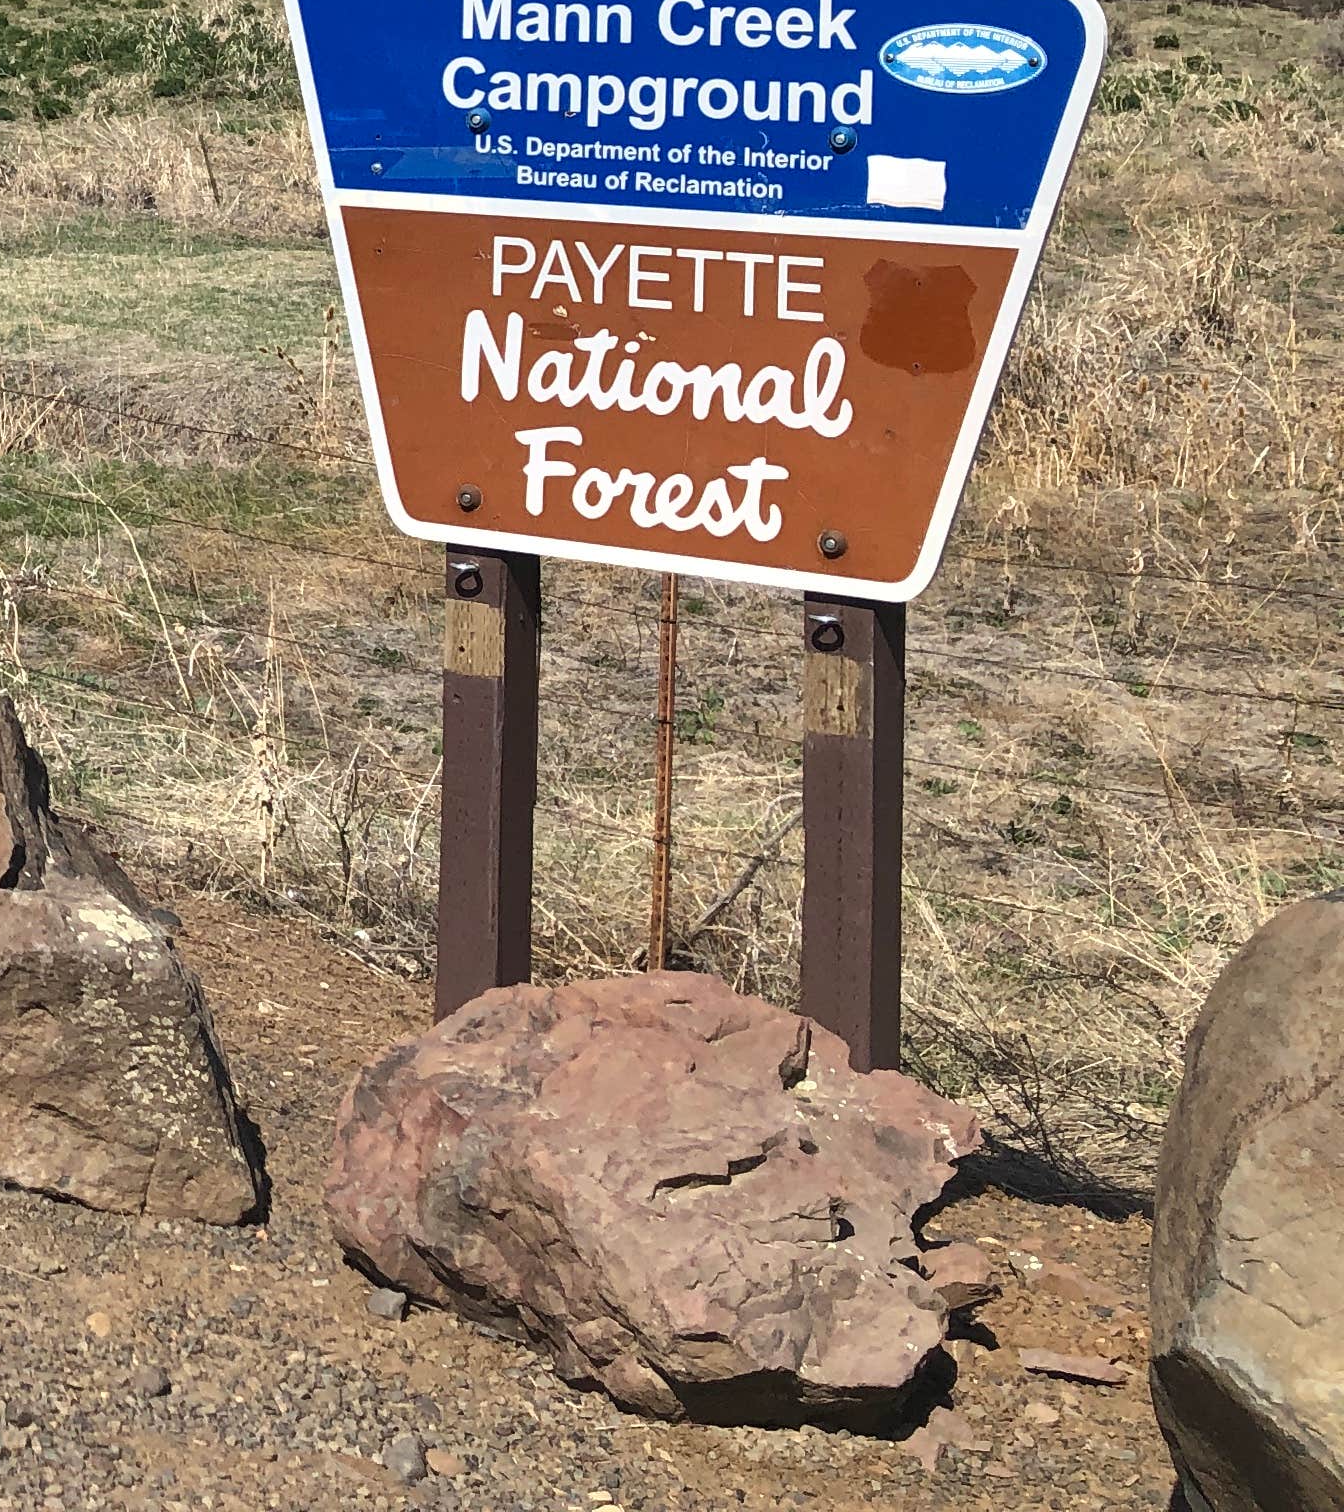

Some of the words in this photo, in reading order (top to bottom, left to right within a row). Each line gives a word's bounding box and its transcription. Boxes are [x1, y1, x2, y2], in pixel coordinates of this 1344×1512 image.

[442, 56, 873, 131] Campground
[475, 134, 518, 155] U.S.
[526, 137, 660, 164] Department
[667, 143, 691, 164] of
[697, 144, 736, 166] the
[743, 147, 833, 171] Interior
[516, 167, 597, 189] Bureau
[604, 170, 629, 190] of
[635, 172, 783, 200] Reclamation
[492, 236, 824, 322] PAYETTE
[461, 309, 853, 438] National
[515, 426, 789, 542] Forest
